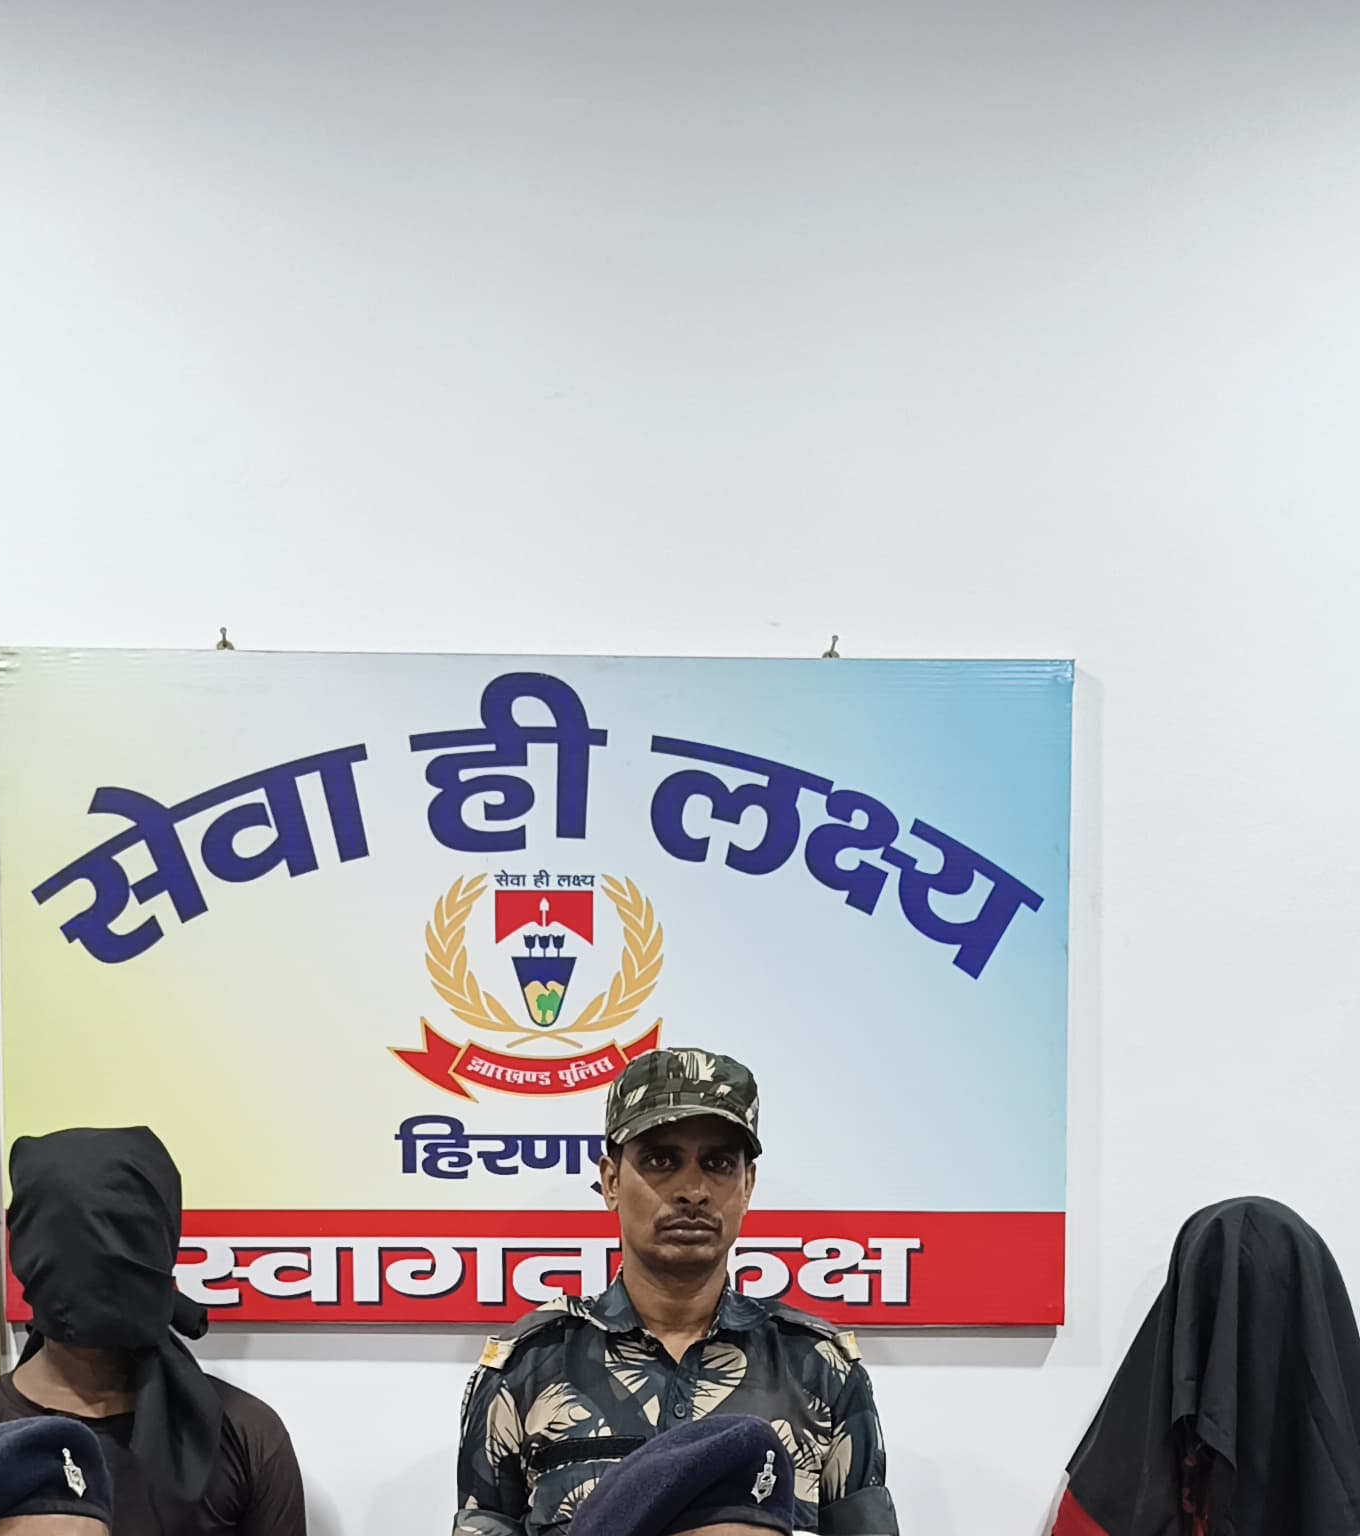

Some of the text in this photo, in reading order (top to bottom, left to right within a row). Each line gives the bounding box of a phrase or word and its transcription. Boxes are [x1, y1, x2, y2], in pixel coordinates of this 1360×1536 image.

[32, 671, 1044, 980] सेवा ही लक्ष्य
[495, 869, 595, 888] सेवा ही लक्ष्य
[466, 1056, 615, 1088] झारखण्ड पुलिस
[175, 1236, 615, 1307] स्वागत
